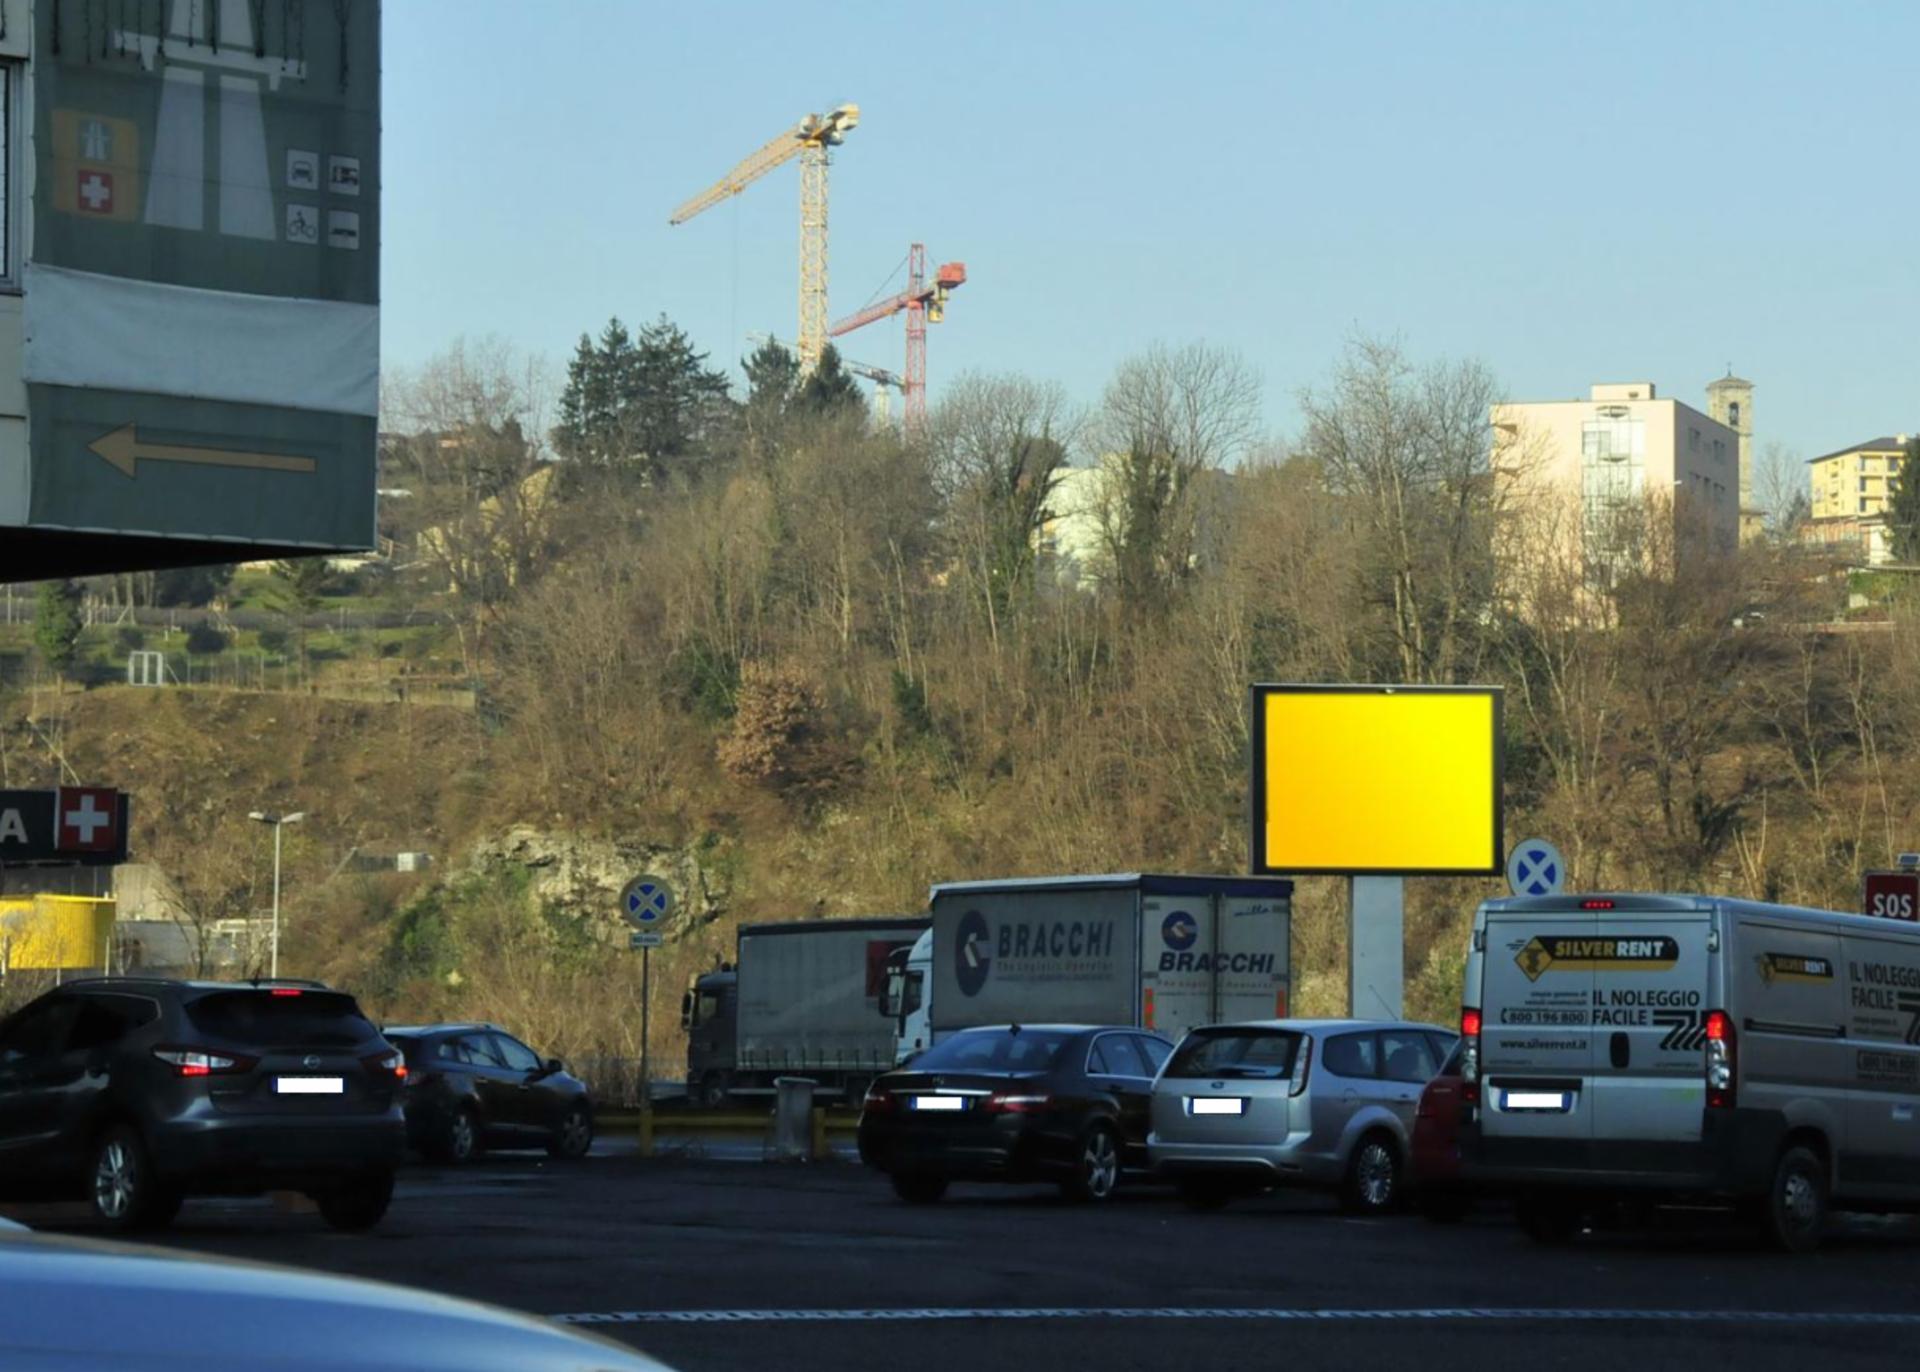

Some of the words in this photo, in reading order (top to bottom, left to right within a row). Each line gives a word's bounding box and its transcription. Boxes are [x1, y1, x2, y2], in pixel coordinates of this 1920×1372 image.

[0, 808, 28, 843] A
[1872, 893, 1912, 917] SOS
[998, 921, 1113, 958] BRACCHI
[1158, 951, 1274, 973] BRACCHI
[1849, 961, 1861, 982] IL
[1593, 990, 1608, 1006] IL
[1612, 990, 1700, 1007] NOLEGGIO
[1851, 986, 1894, 1010] FACILE
[1509, 1012, 1532, 1023] 800
[1536, 1012, 1558, 1023] 196
[1560, 1012, 1585, 1023] 800
[1592, 1009, 1647, 1025] FACILE
[1499, 1038, 1587, 1050] www.silverrent.it
